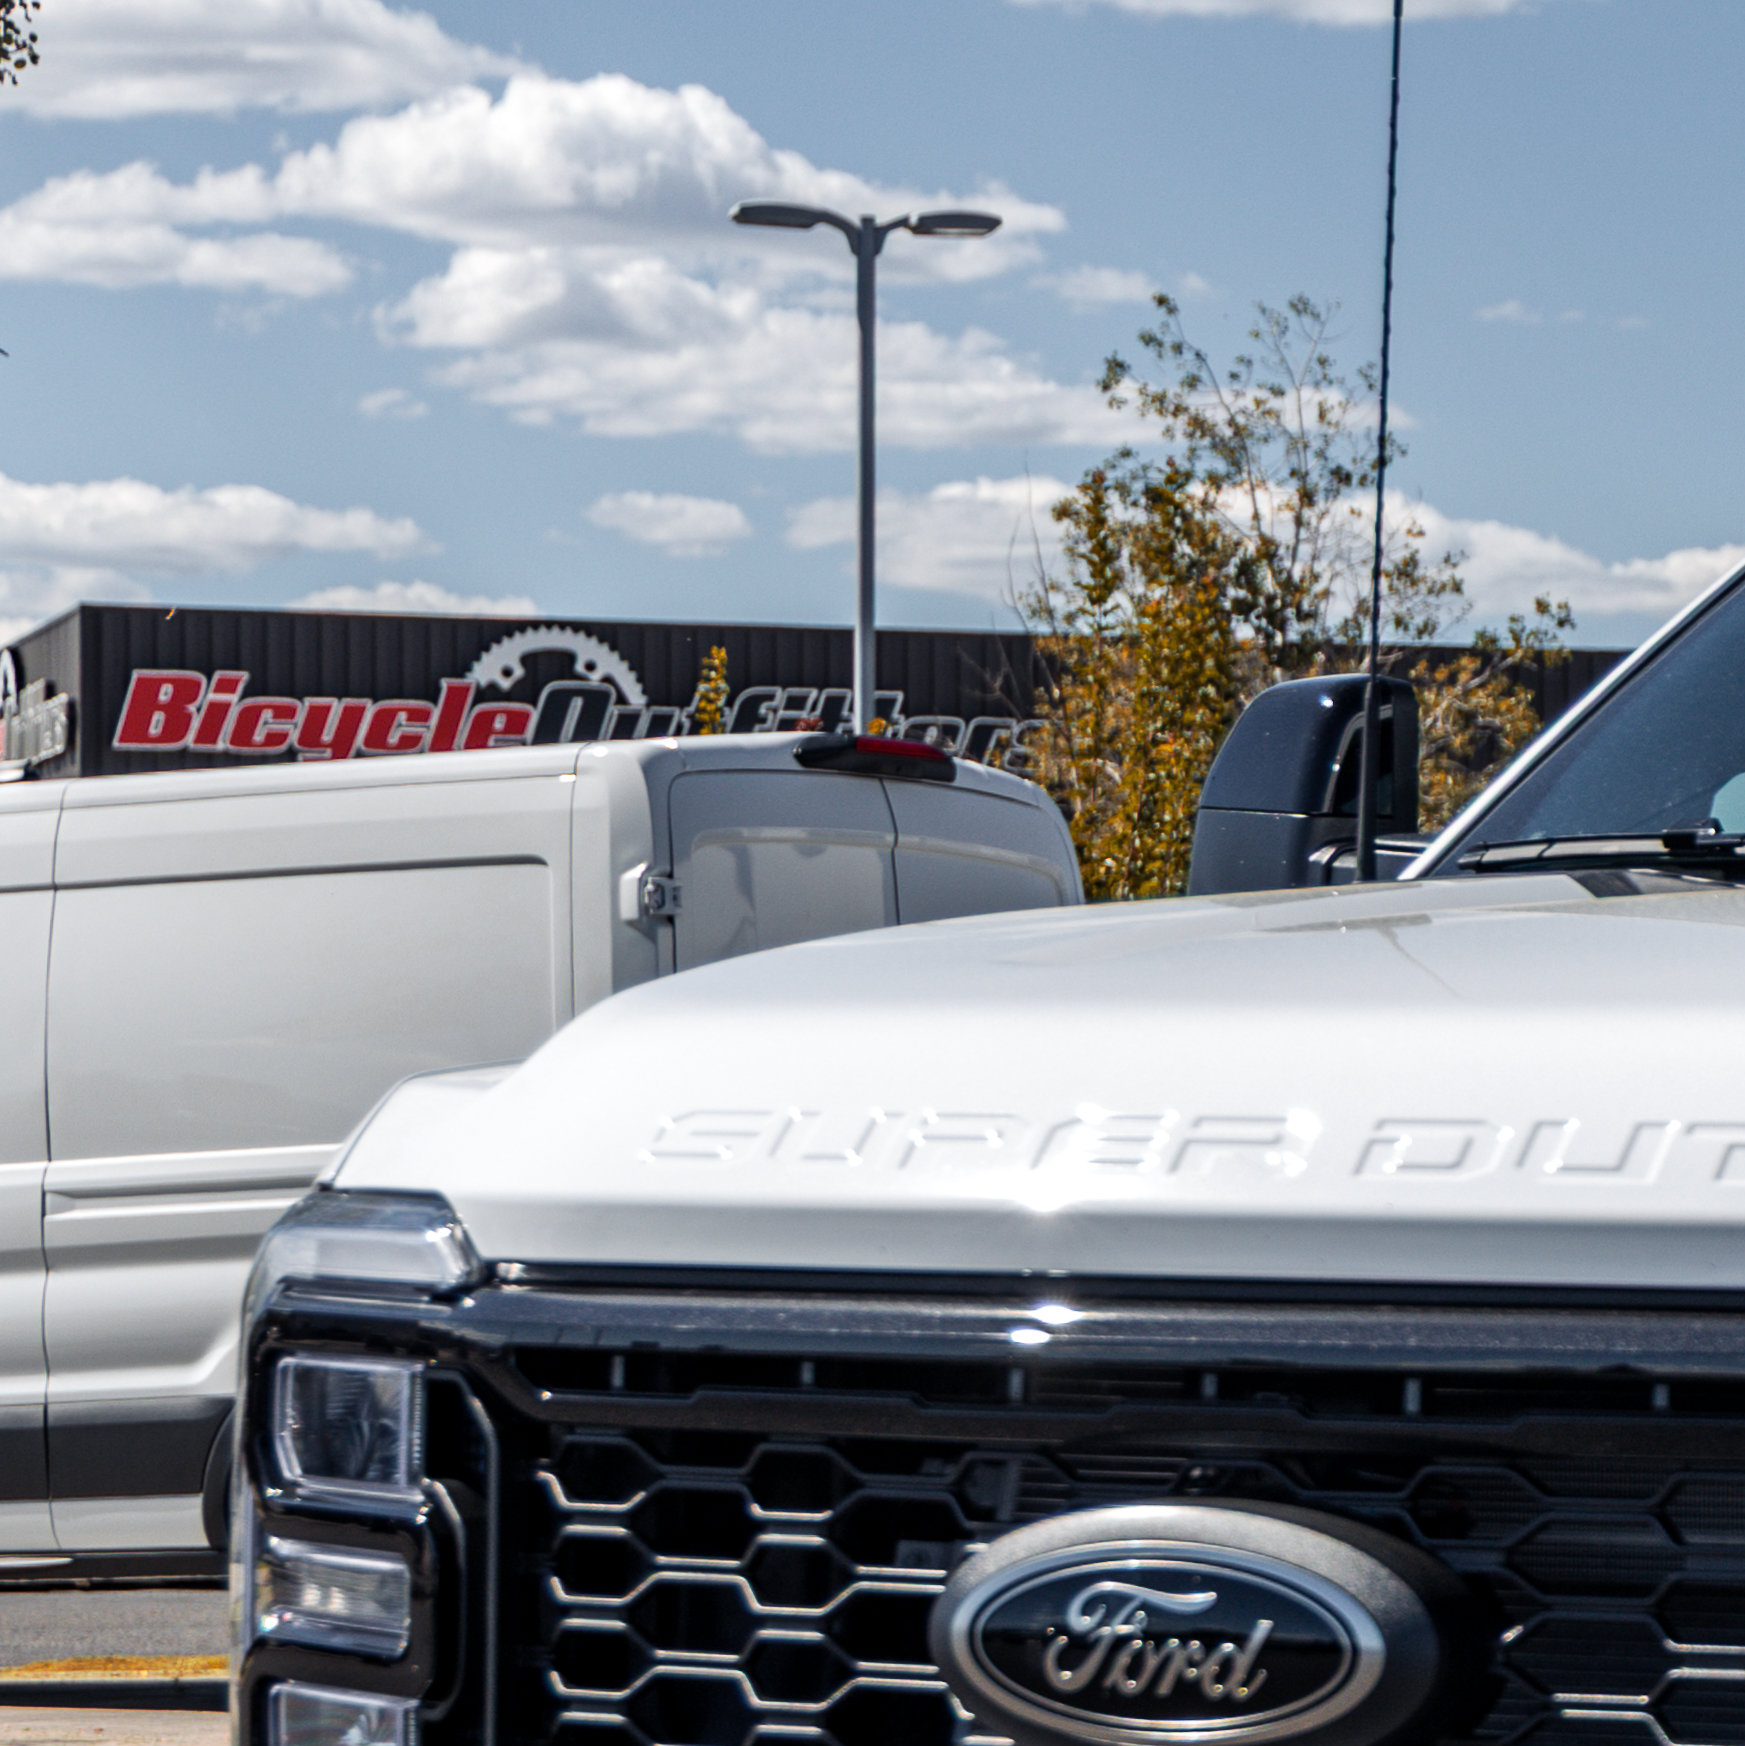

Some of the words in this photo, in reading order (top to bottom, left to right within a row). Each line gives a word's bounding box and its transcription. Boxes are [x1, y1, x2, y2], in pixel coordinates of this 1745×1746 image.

[112, 669, 536, 762] Bicycle
[641, 1107, 1316, 1176] SUPER
[1043, 1580, 1275, 1699] Ford
